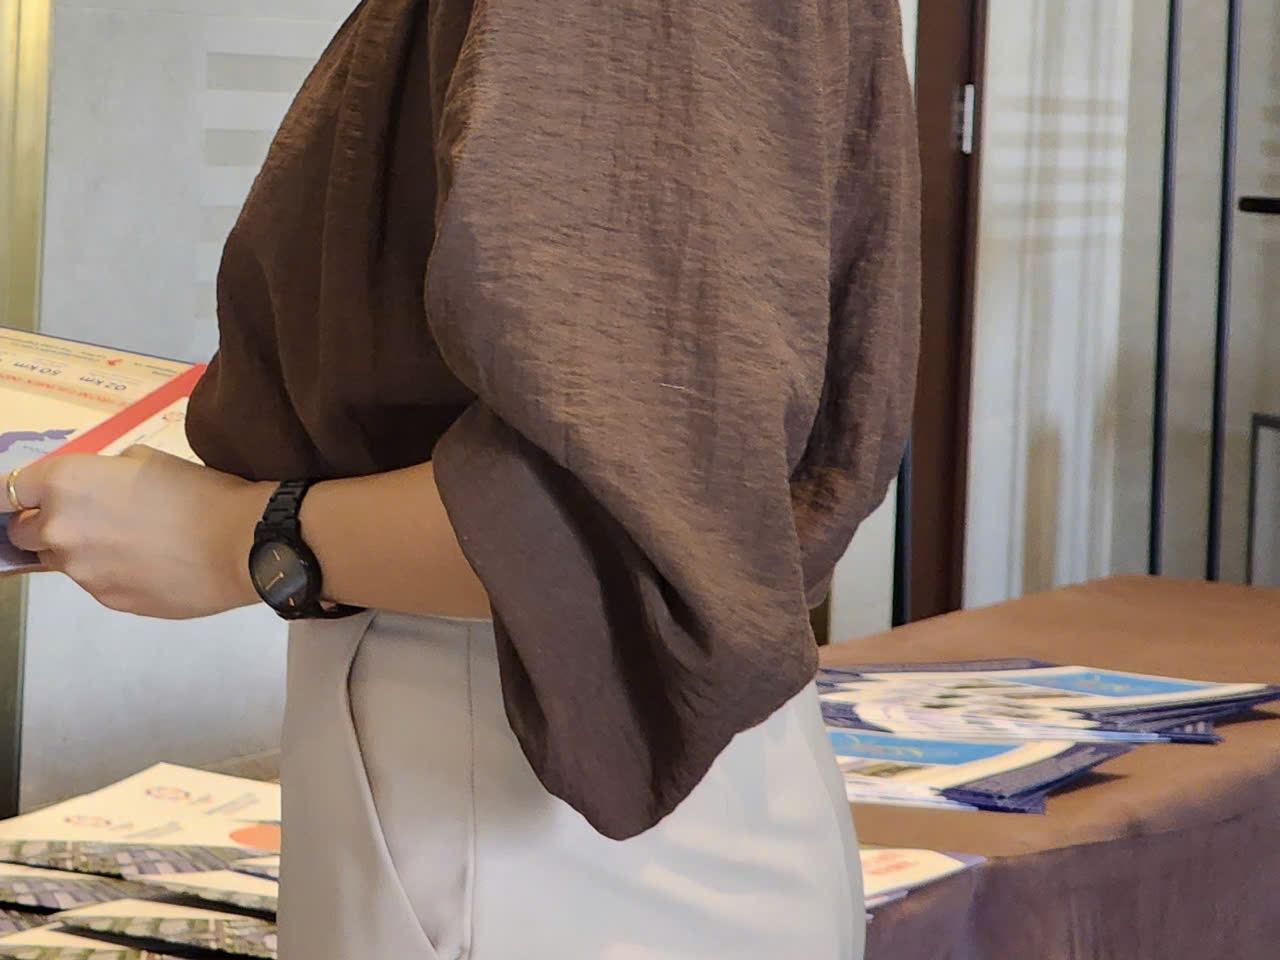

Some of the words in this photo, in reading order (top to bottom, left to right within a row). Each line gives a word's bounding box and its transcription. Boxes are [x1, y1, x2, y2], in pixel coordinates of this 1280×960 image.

[13, 361, 38, 371] km
[80, 375, 103, 386] km
[104, 381, 127, 391] 02
